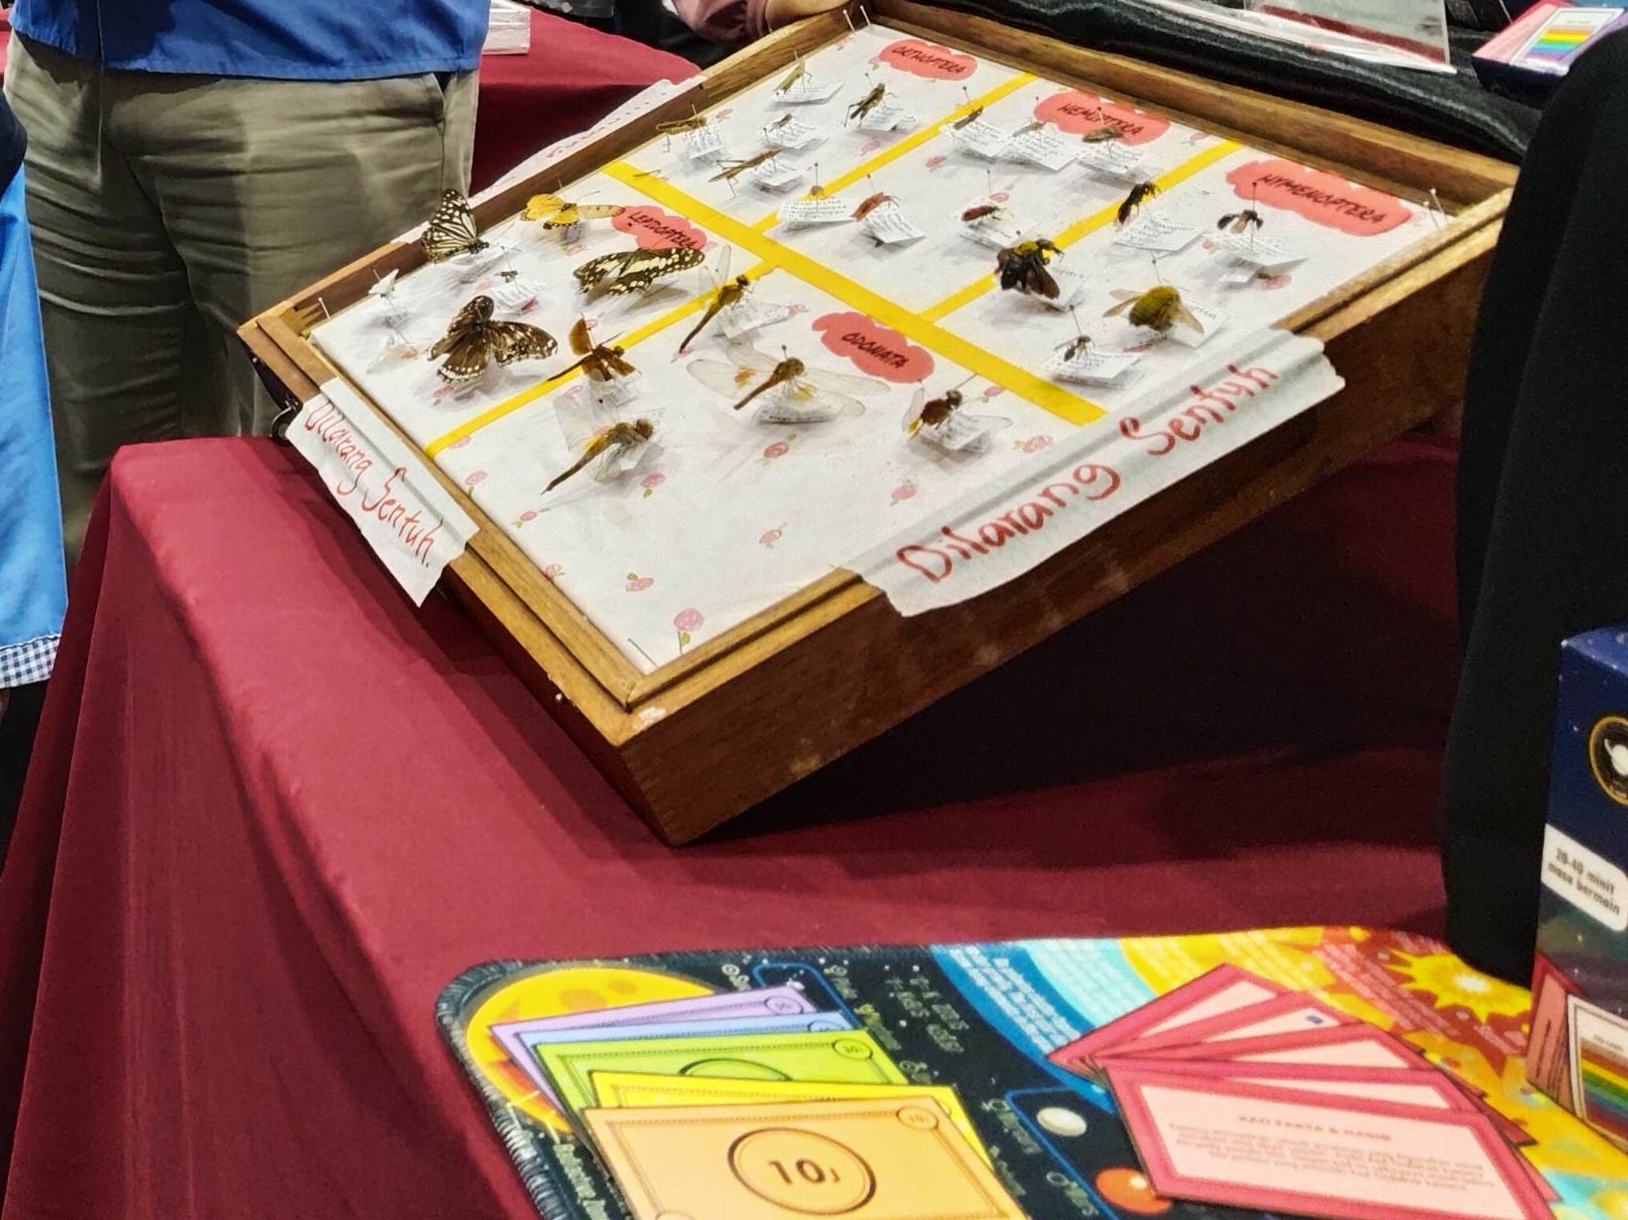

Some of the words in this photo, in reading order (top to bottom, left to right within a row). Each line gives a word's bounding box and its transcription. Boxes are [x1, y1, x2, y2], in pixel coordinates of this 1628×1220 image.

[891, 46, 966, 75] ORTHOPTERA
[1258, 173, 1386, 224] HYMENOPTERA
[842, 331, 910, 369] ODONATA
[304, 399, 373, 496] Dilarang
[897, 463, 1121, 582] Dilarang
[1119, 362, 1278, 456] Sentuh
